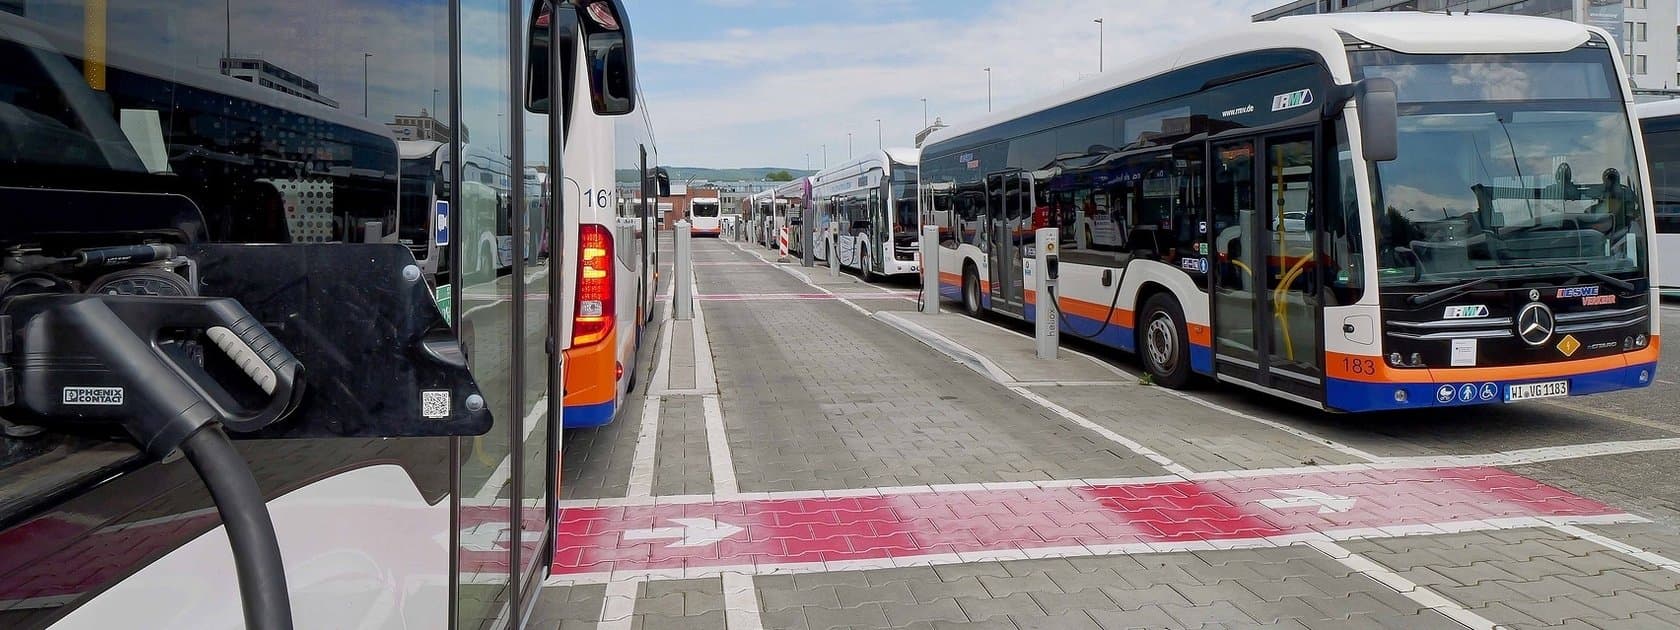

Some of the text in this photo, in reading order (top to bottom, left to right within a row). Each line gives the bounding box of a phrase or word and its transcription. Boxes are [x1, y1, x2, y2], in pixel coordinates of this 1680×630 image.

[1221, 104, 1255, 118] www.rmv.de
[1564, 286, 1599, 297] ESWE
[1343, 357, 1376, 376] 183
[1511, 382, 1567, 399] WI VG 1183
